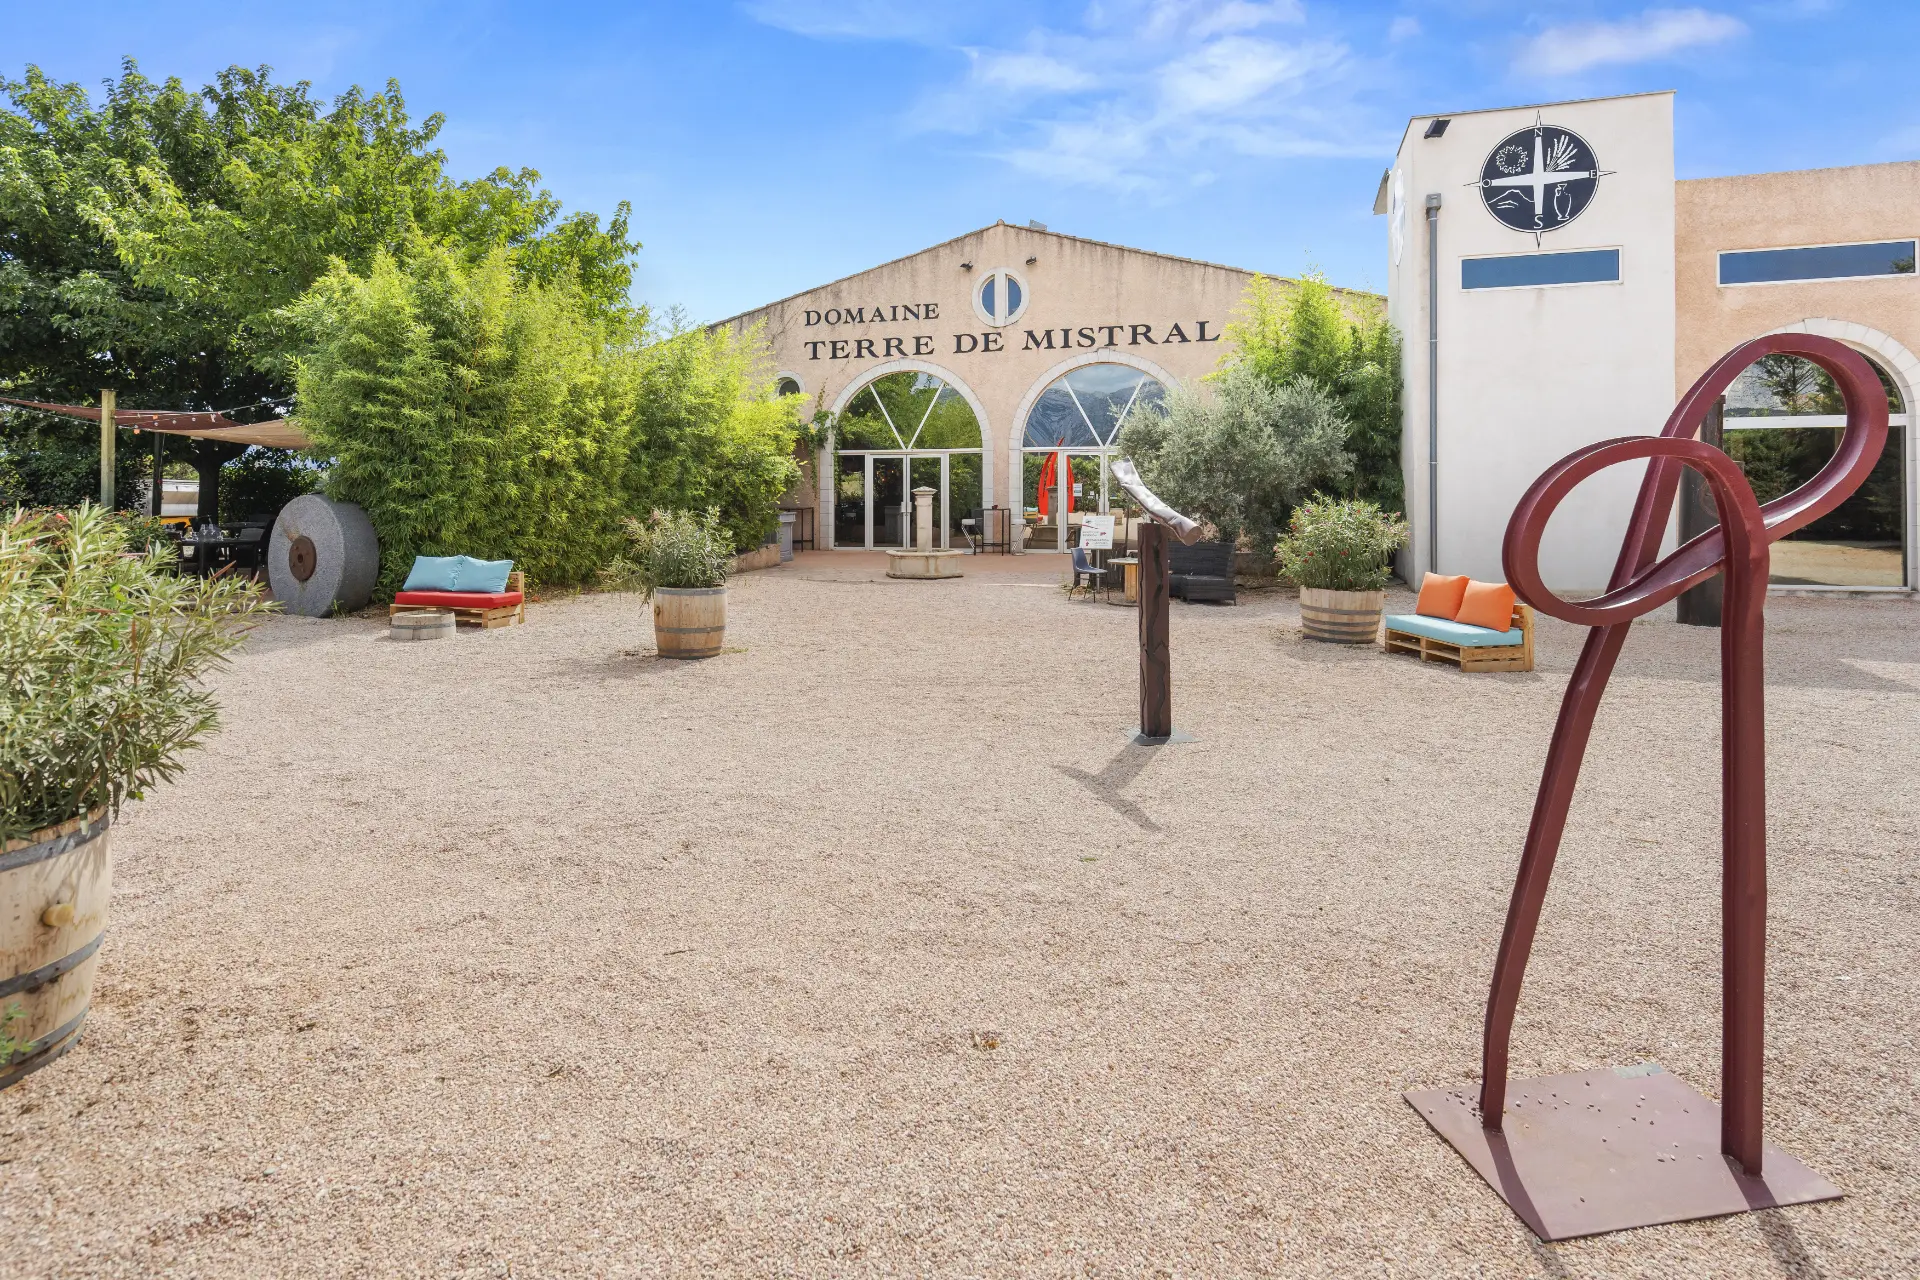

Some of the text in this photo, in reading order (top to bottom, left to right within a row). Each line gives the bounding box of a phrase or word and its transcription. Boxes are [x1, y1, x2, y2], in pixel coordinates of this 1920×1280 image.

[1534, 128, 1543, 137] N
[1590, 170, 1597, 178] E
[1482, 179, 1492, 188] O
[1533, 215, 1543, 229] S
[804, 303, 940, 326] DOMAINE
[804, 321, 1221, 360] TERRE DE MISTRAL
